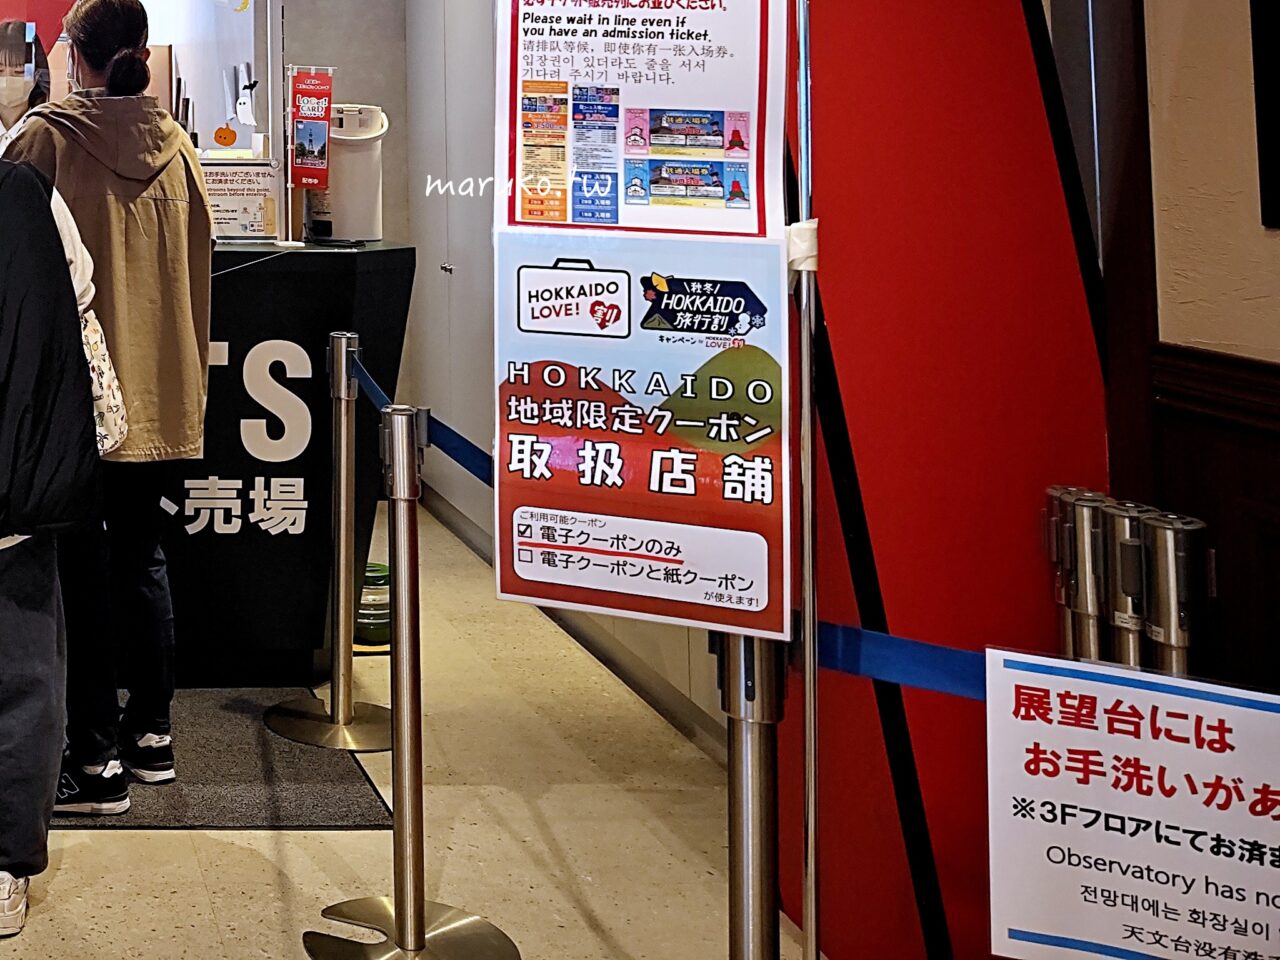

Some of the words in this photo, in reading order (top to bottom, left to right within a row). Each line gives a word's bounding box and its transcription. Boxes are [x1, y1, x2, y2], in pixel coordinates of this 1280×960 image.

[522, 13, 562, 24] Please
[565, 14, 594, 25] wait
[597, 15, 609, 25] in
[613, 15, 637, 26] line
[641, 18, 670, 27] even
[675, 16, 686, 27] if
[522, 28, 544, 38] you
[548, 26, 577, 37] have
[582, 29, 597, 37] an
[601, 27, 664, 40] admission
[669, 29, 711, 42] ticket.
[522, 68, 561, 80] 기다려
[570, 69, 608, 82] 주시기
[523, 56, 574, 68] 입장권이
[584, 57, 637, 70] 있더라도
[646, 59, 671, 71] 줄을
[680, 60, 706, 72] 서서
[528, 281, 619, 303] HOKKAIDO
[661, 294, 745, 313] HOKKAIDO
[531, 303, 580, 320] LOVE!
[673, 312, 729, 332] 旅行割
[507, 361, 773, 404] HOKKAIDO
[508, 395, 774, 444] 地域限定クーポン
[507, 433, 774, 505] 取扱店舗
[519, 510, 607, 529] ご利用可能クーポン
[540, 525, 683, 558] 電子クーポンのみ
[540, 550, 754, 592] 電子クーポンと紙クーポン
[1012, 684, 1236, 754] 展望台には
[1023, 741, 1280, 822] お手洗いがあ
[1046, 846, 1196, 895] Observatory
[1205, 876, 1246, 902] has
[1080, 884, 1181, 921] 전망대에는
[1188, 908, 1270, 940] 화장실이
